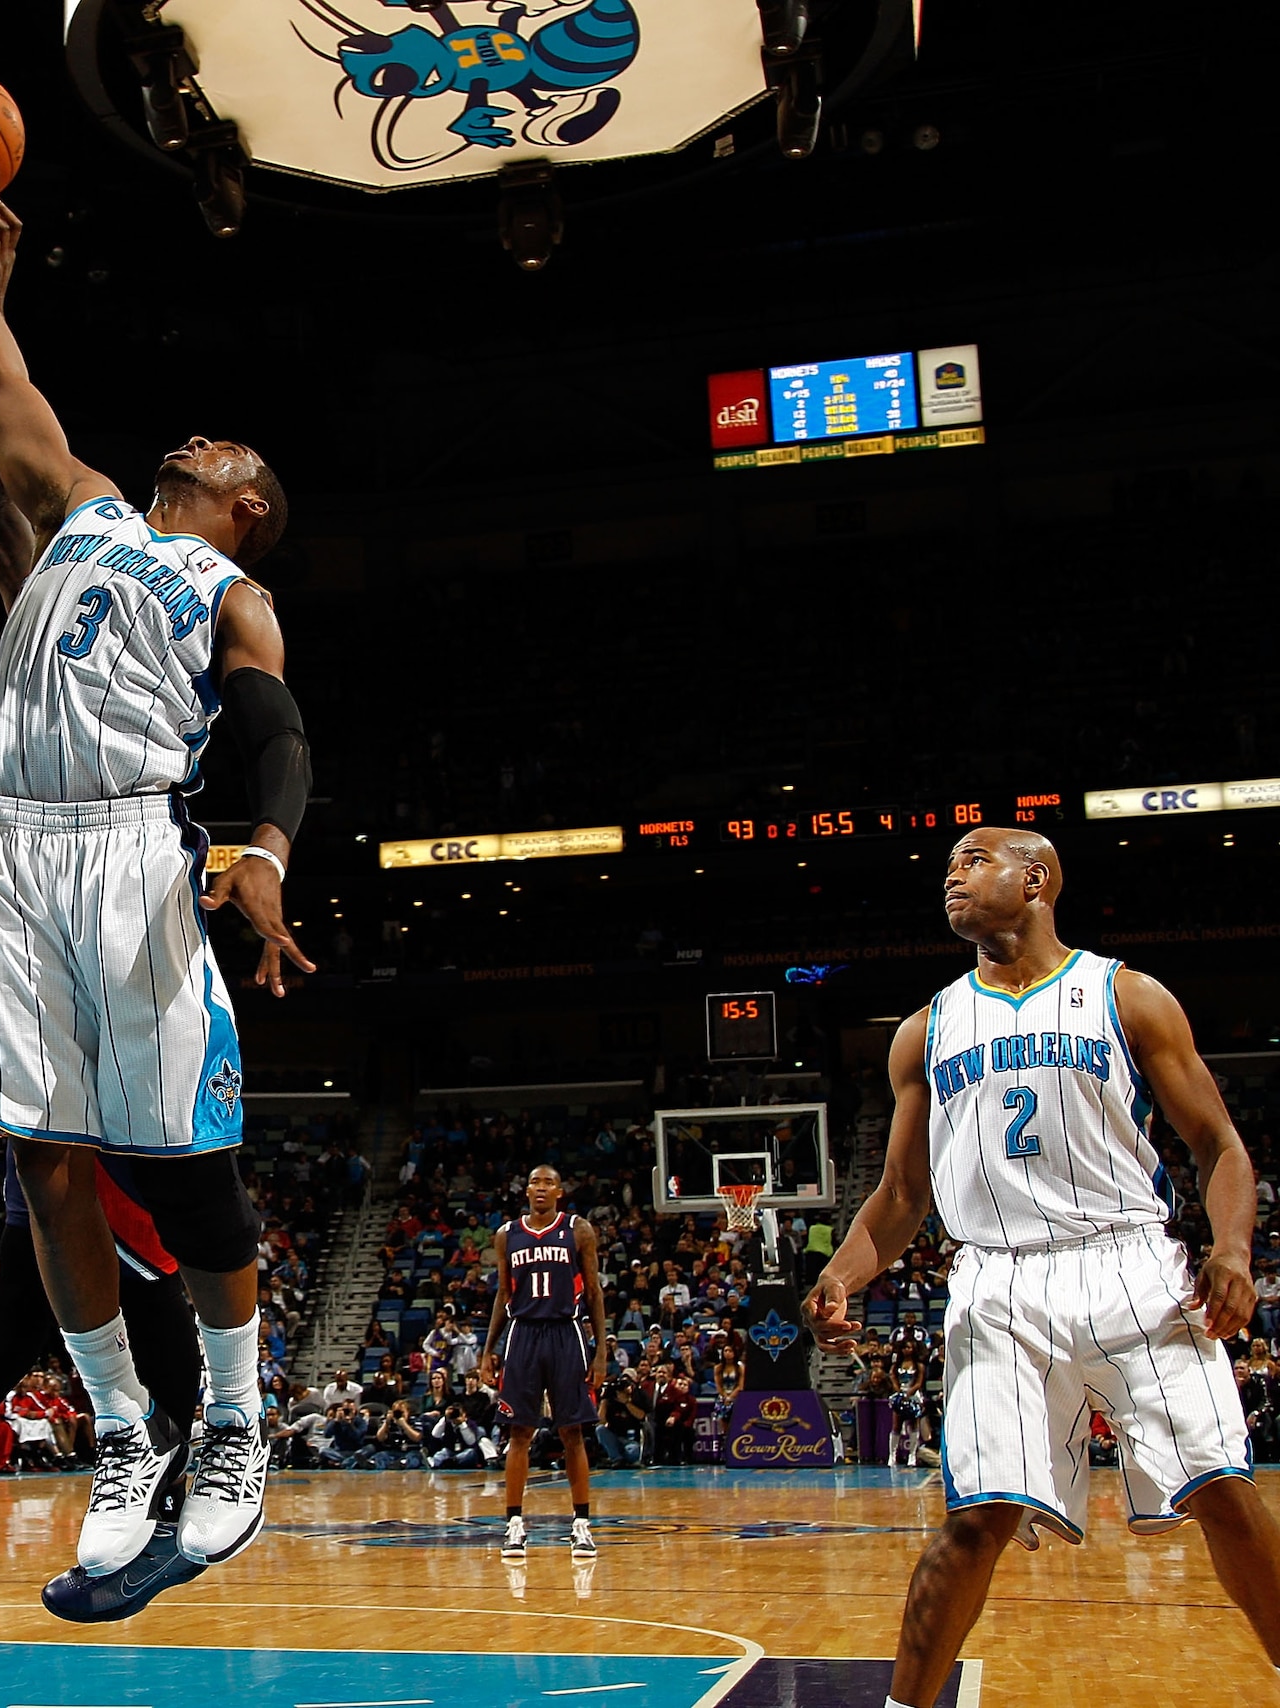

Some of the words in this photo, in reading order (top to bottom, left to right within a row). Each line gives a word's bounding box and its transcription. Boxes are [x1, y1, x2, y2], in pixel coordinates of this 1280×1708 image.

[716, 398, 759, 425] dish
[714, 453, 756, 468] PEOPLES
[801, 444, 843, 459] PEOPLES
[895, 434, 938, 449] PEOPLES
[38, 534, 111, 574] NEW
[97, 543, 209, 642] ORLEANS
[57, 585, 113, 660] 3
[1017, 793, 1061, 808] HAWKS
[1142, 788, 1198, 812] CRC
[640, 820, 695, 835] HORNETS
[728, 820, 754, 840] 93
[786, 823, 797, 838] 2
[812, 811, 854, 836] 15.5
[880, 814, 893, 830] 4
[955, 804, 982, 825] 86
[1016, 810, 1035, 822] FLS
[430, 840, 479, 861] CRC
[506, 832, 621, 846] TRANSPORTATION
[670, 835, 689, 847] FLS
[1101, 929, 1198, 946] COMMERCIAL
[723, 950, 801, 967] INSURANCE
[804, 946, 860, 963] AGENCY
[864, 945, 881, 960] OF
[886, 944, 912, 959] THE
[463, 965, 531, 983] EMPLOYEE
[533, 961, 596, 979] BENEFITS
[933, 1044, 984, 1106] NEW
[991, 1032, 1111, 1082] ORLEANS
[1003, 1086, 1041, 1159] 2
[511, 1246, 570, 1268] ATLANTA
[531, 1271, 551, 1299] 11
[731, 1433, 776, 1460] Crown
[766, 1433, 826, 1462] Royal
